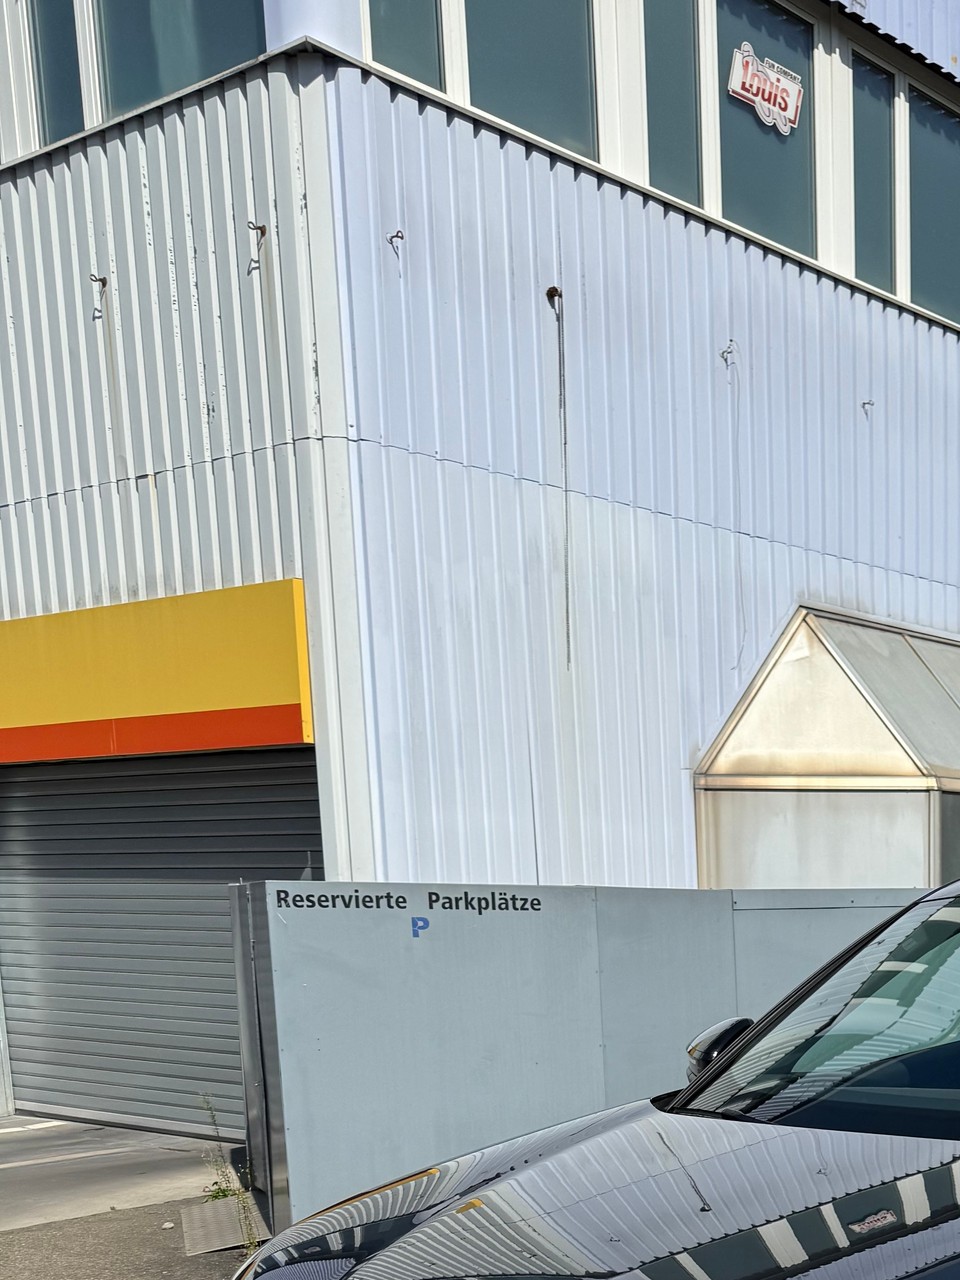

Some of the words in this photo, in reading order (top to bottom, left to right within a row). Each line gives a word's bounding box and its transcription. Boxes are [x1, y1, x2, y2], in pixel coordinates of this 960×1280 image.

[765, 59, 776, 71] FUN
[776, 65, 801, 82] COMPANY
[741, 60, 790, 112] Louis
[276, 889, 408, 910] Reservierte
[428, 891, 542, 915] Parkplätze
[411, 917, 430, 938] P
